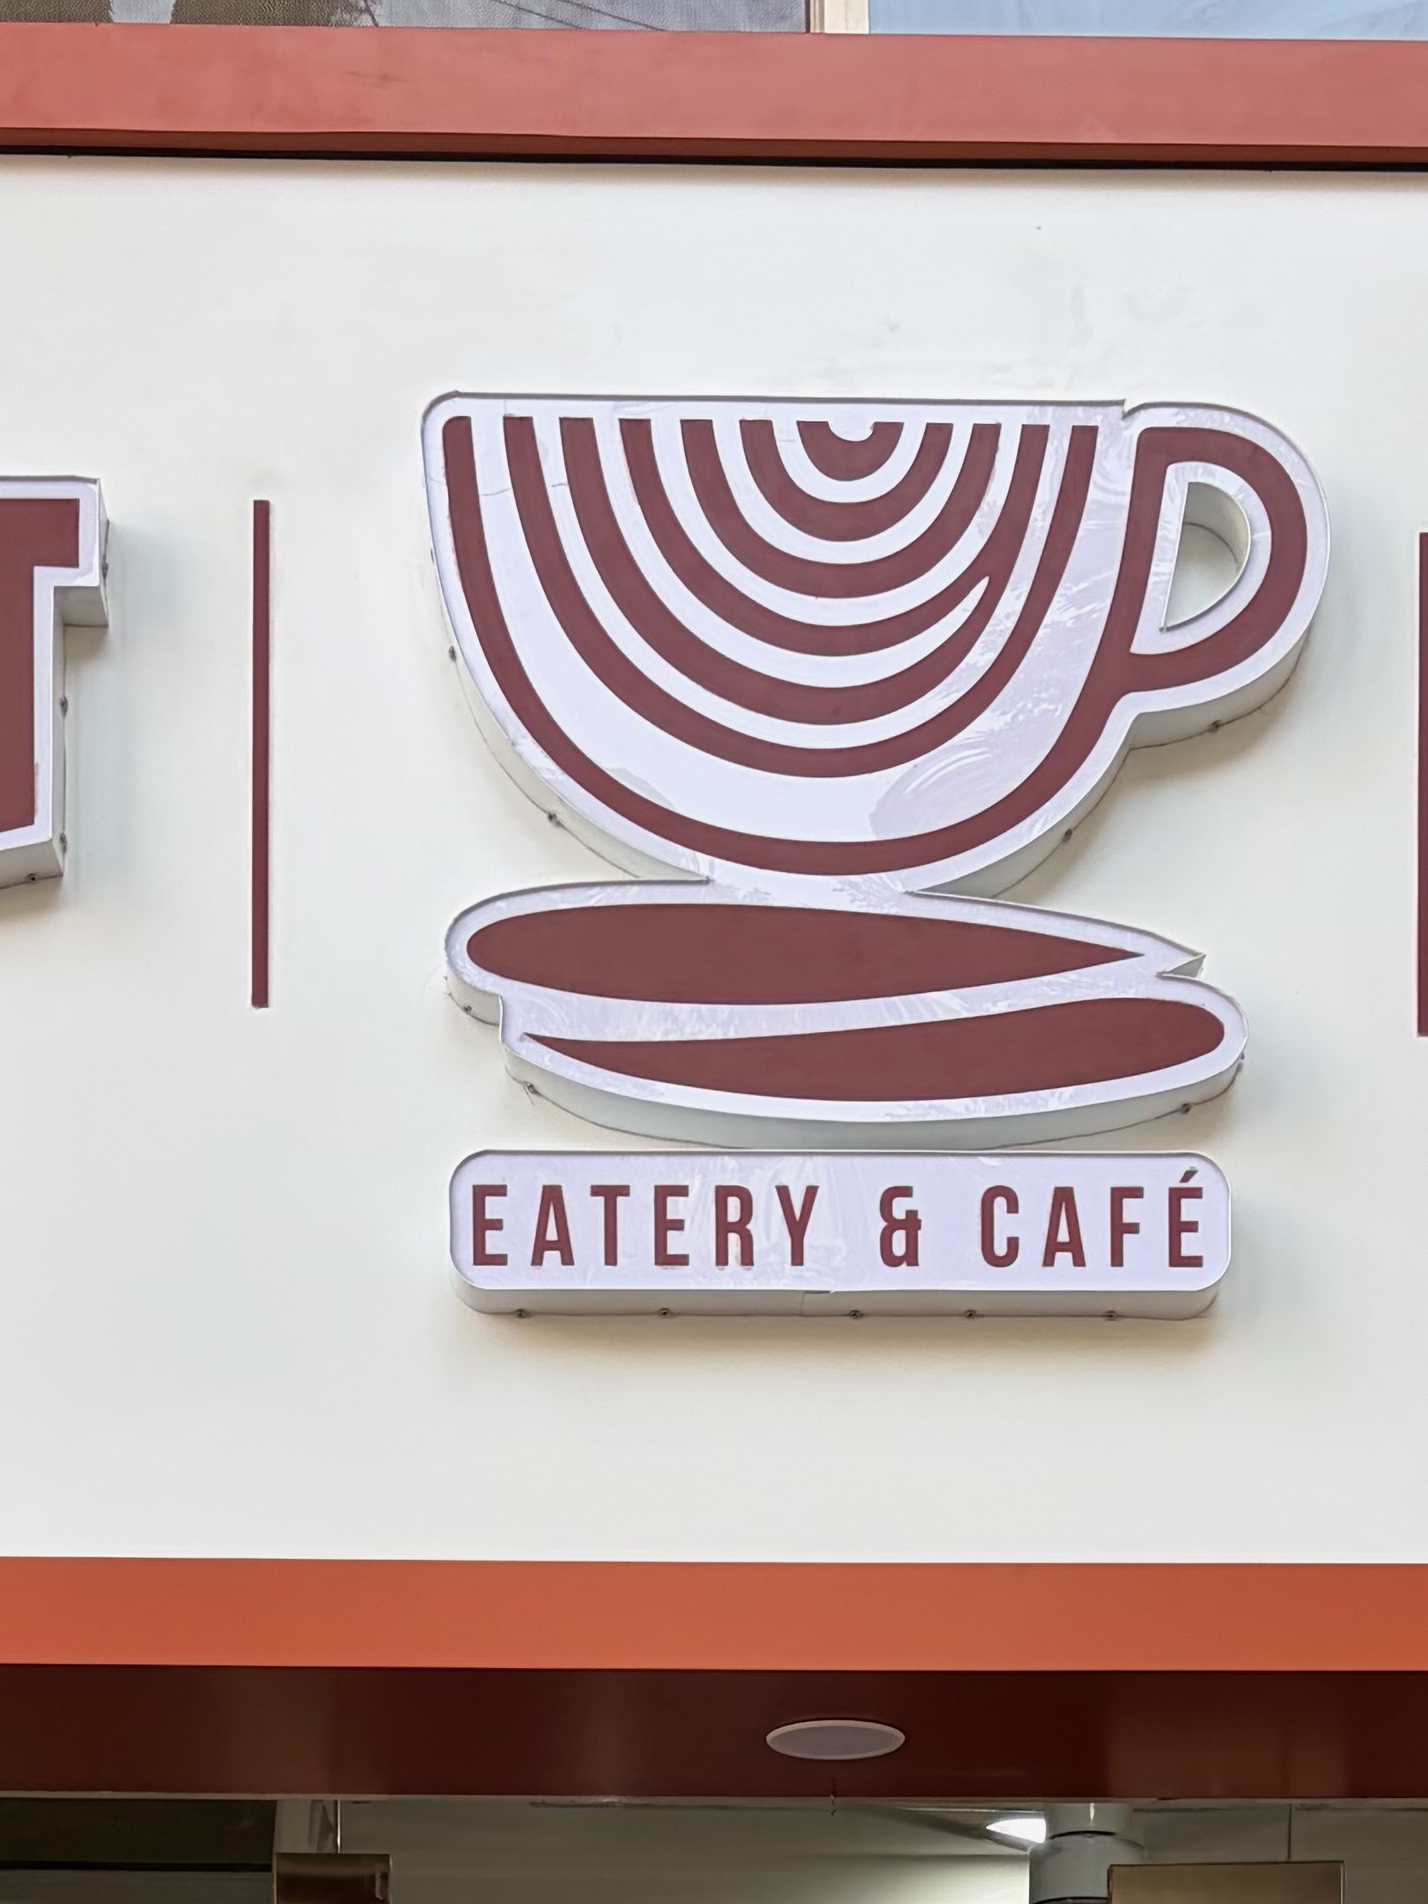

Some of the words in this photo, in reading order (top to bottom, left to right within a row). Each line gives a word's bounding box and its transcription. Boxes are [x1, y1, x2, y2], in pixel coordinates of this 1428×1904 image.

[471, 1183, 820, 1268] EATERY
[878, 1184, 923, 1269] &
[979, 1169, 1205, 1269] CAFÉ
